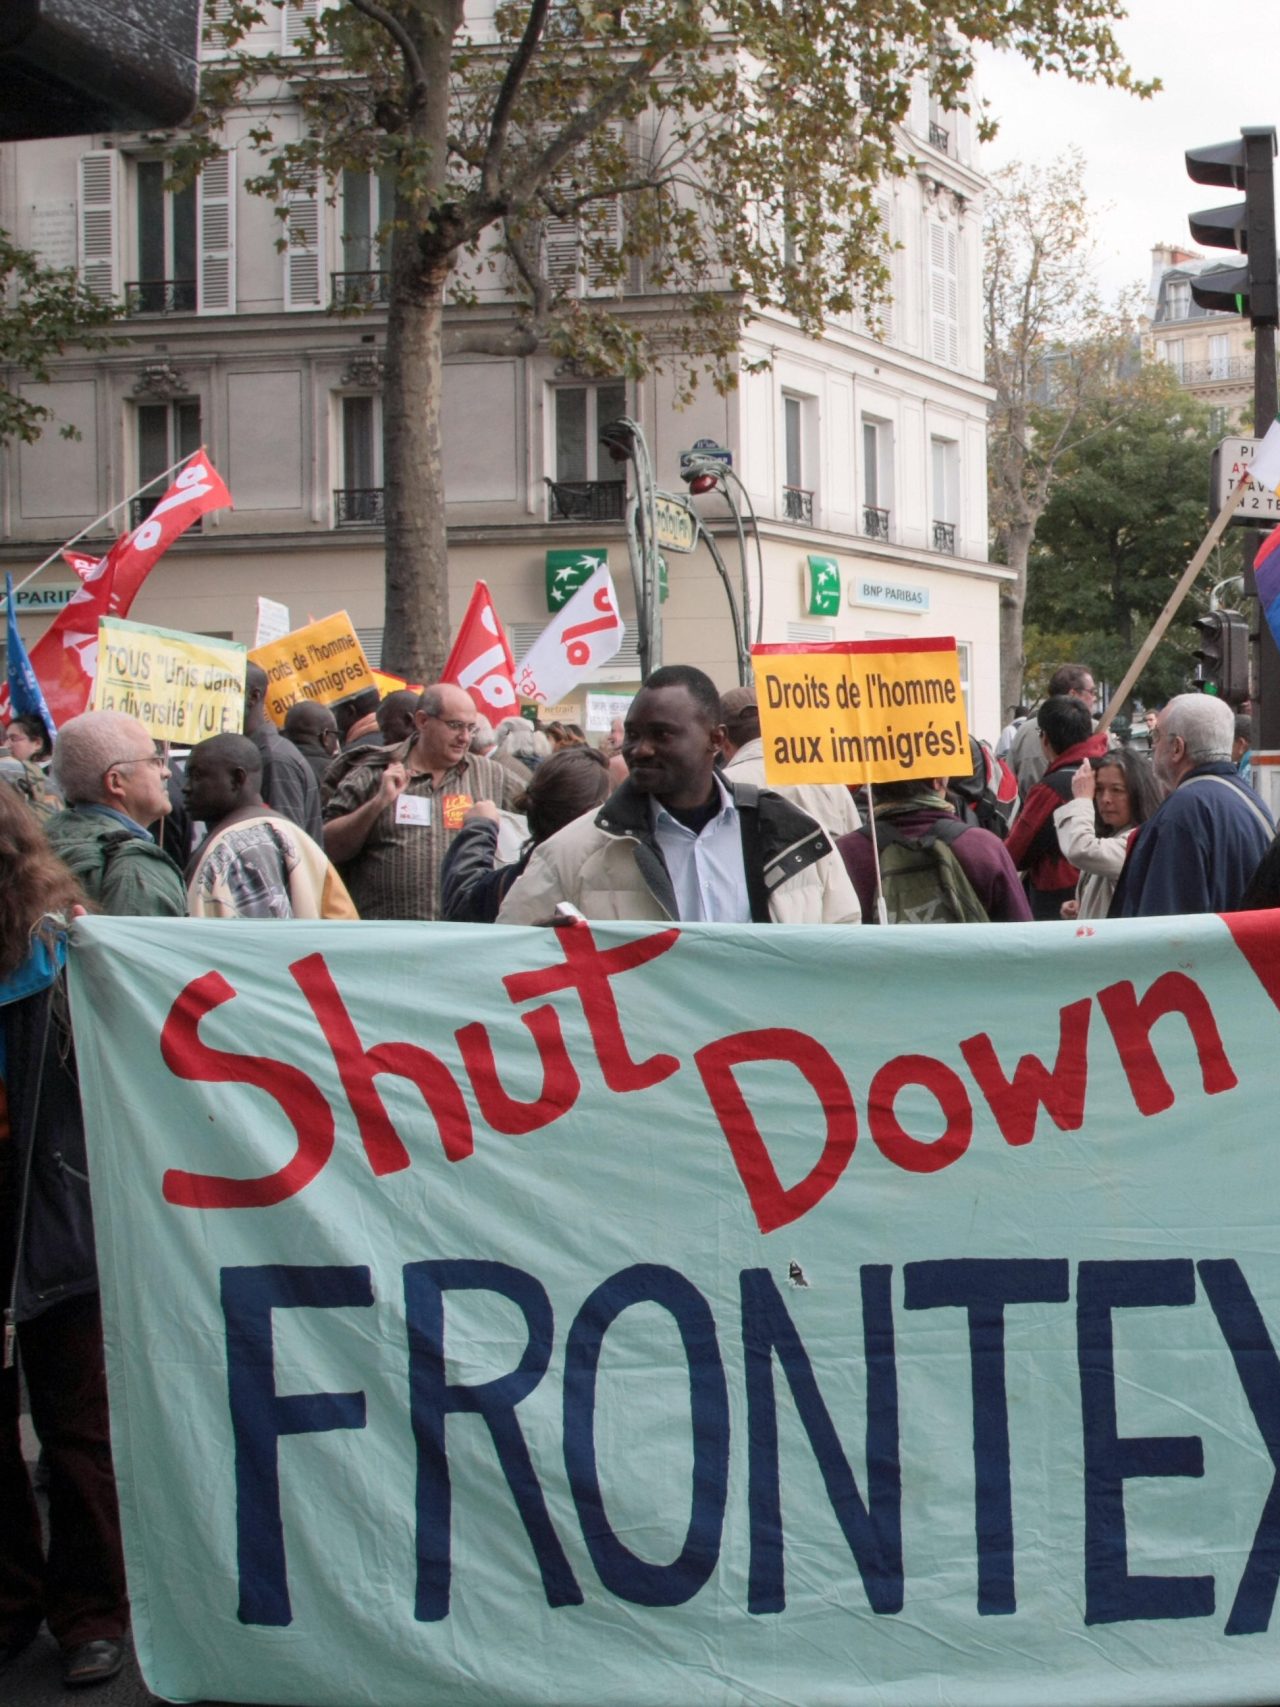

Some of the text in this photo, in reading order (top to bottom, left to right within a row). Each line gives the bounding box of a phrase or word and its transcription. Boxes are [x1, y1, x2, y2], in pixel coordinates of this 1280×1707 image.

[1241, 446, 1254, 458] PI
[1252, 498, 1259, 509] 2
[863, 583, 923, 604] BNP PARIBAS
[106, 645, 151, 679] TOUS
[204, 663, 242, 693] dans
[267, 634, 356, 684] roits de l'homme
[272, 691, 296, 714] aux
[765, 673, 956, 709] Droits de l'homme
[774, 721, 965, 768] aux immigrés!
[162, 918, 681, 1209] Shut
